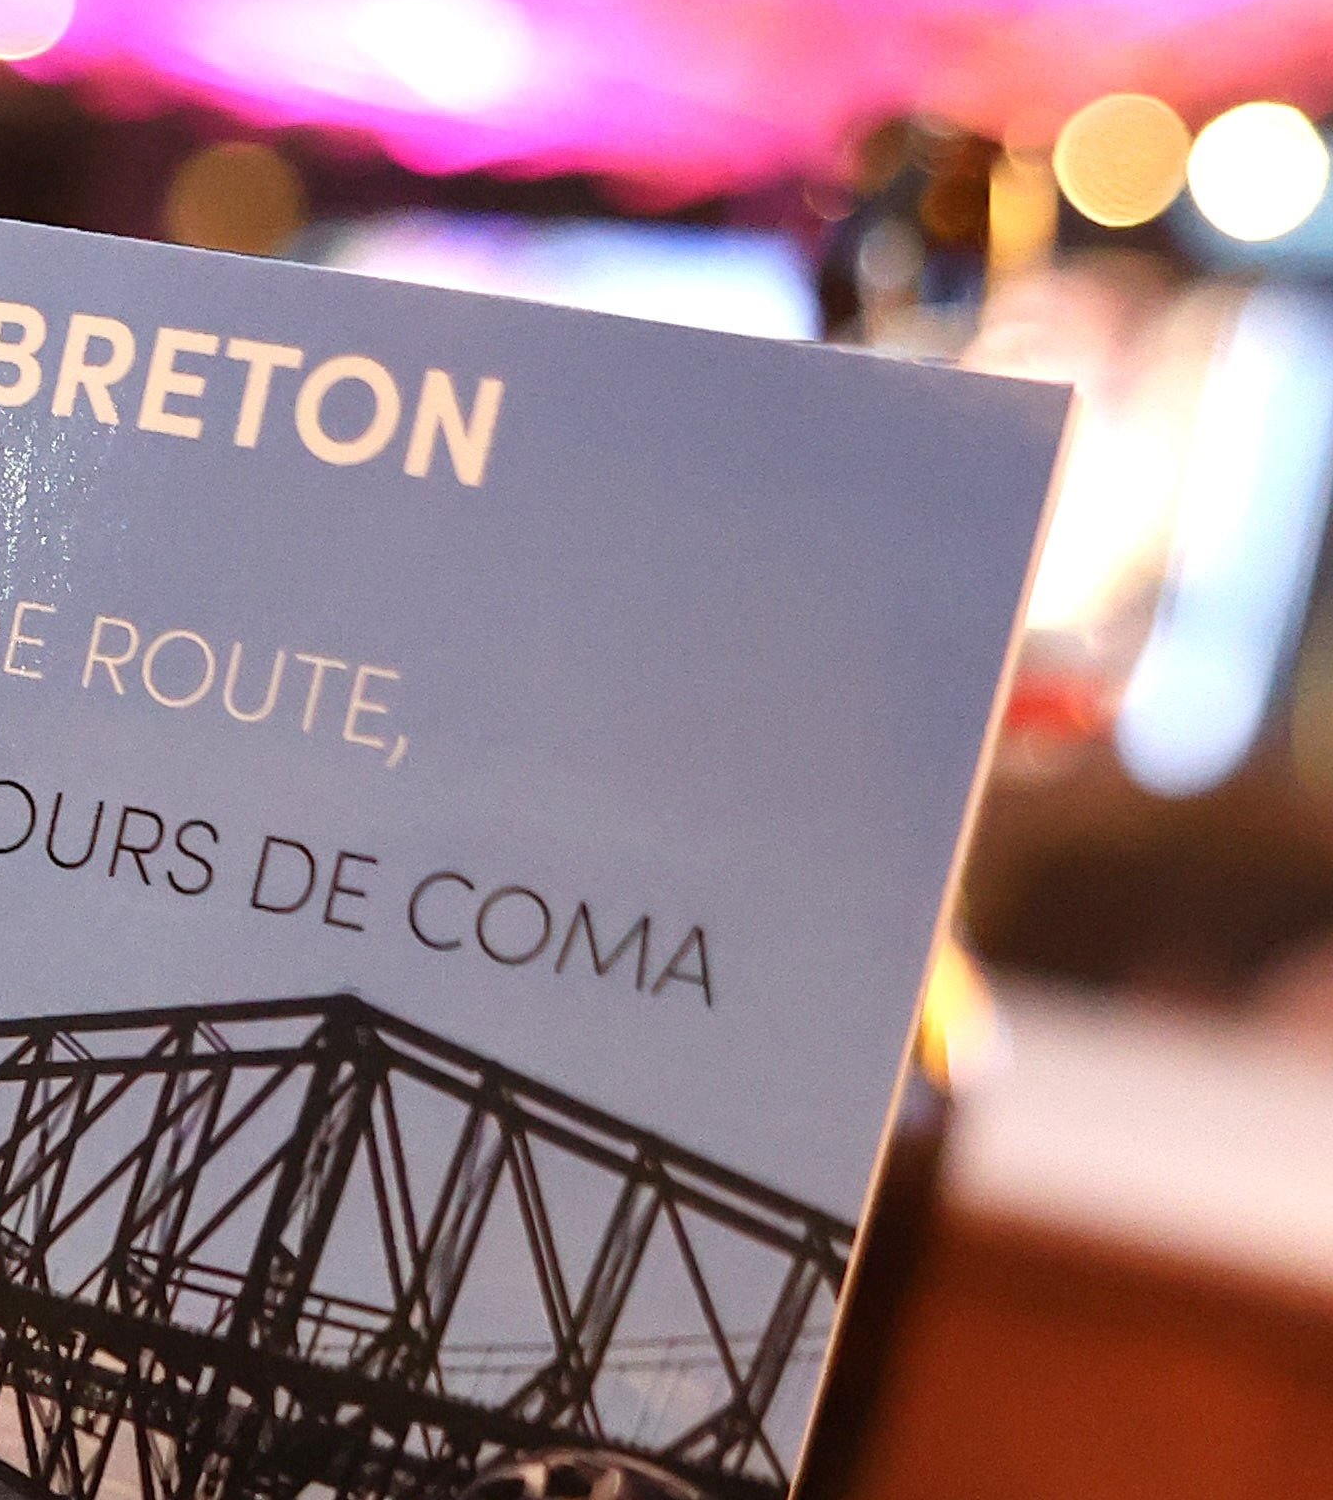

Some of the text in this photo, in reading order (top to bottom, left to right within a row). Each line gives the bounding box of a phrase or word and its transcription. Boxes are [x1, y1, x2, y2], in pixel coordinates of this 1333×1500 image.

[80, 612, 413, 770] ROUTE,
[245, 836, 383, 934] DE
[405, 870, 719, 1010] COMA
